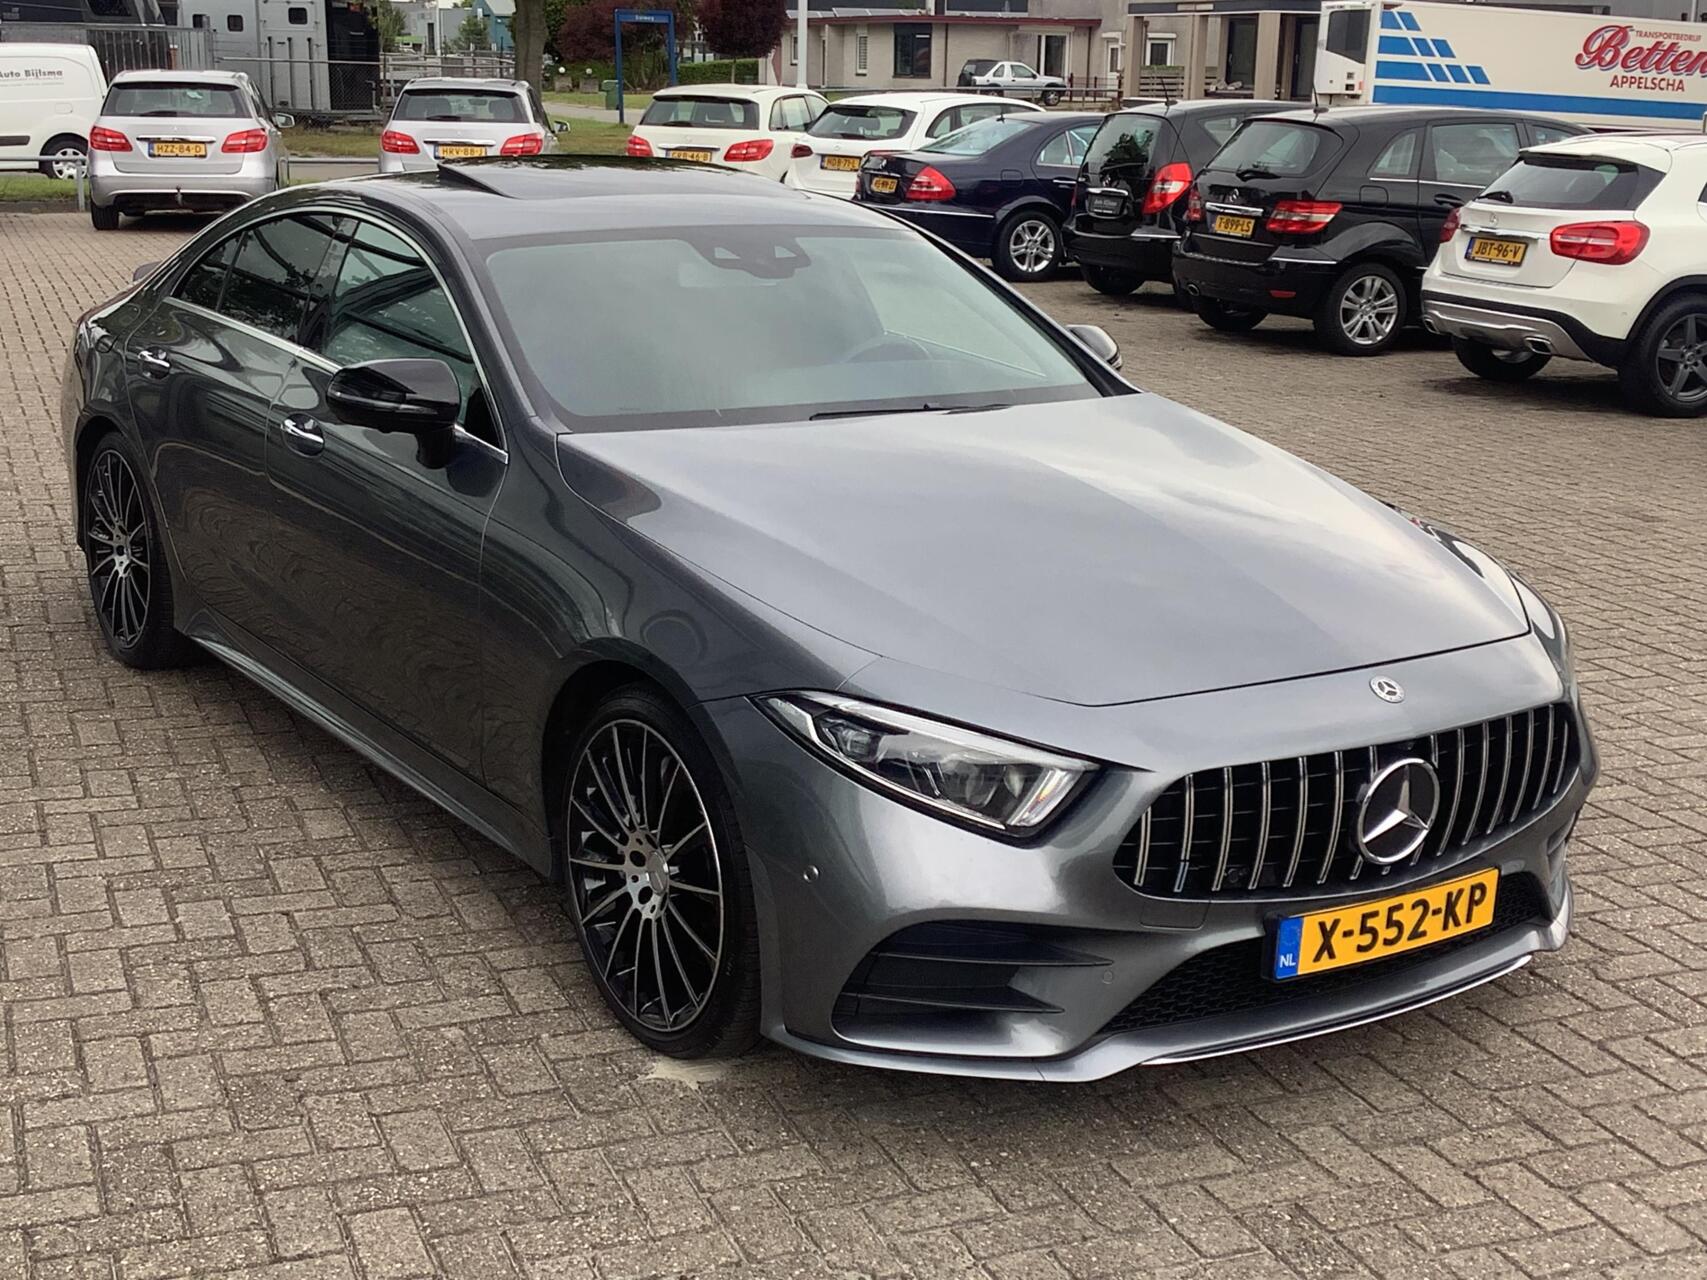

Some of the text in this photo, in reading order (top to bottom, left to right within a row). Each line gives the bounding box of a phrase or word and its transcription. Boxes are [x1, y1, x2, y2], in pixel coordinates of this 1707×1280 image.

[24, 69, 63, 79] Bijlsma
[1610, 75, 1685, 92] APPELSCHA
[1475, 241, 1521, 259] JBT-96-V
[1279, 882, 1487, 967] NL X-552-KP
